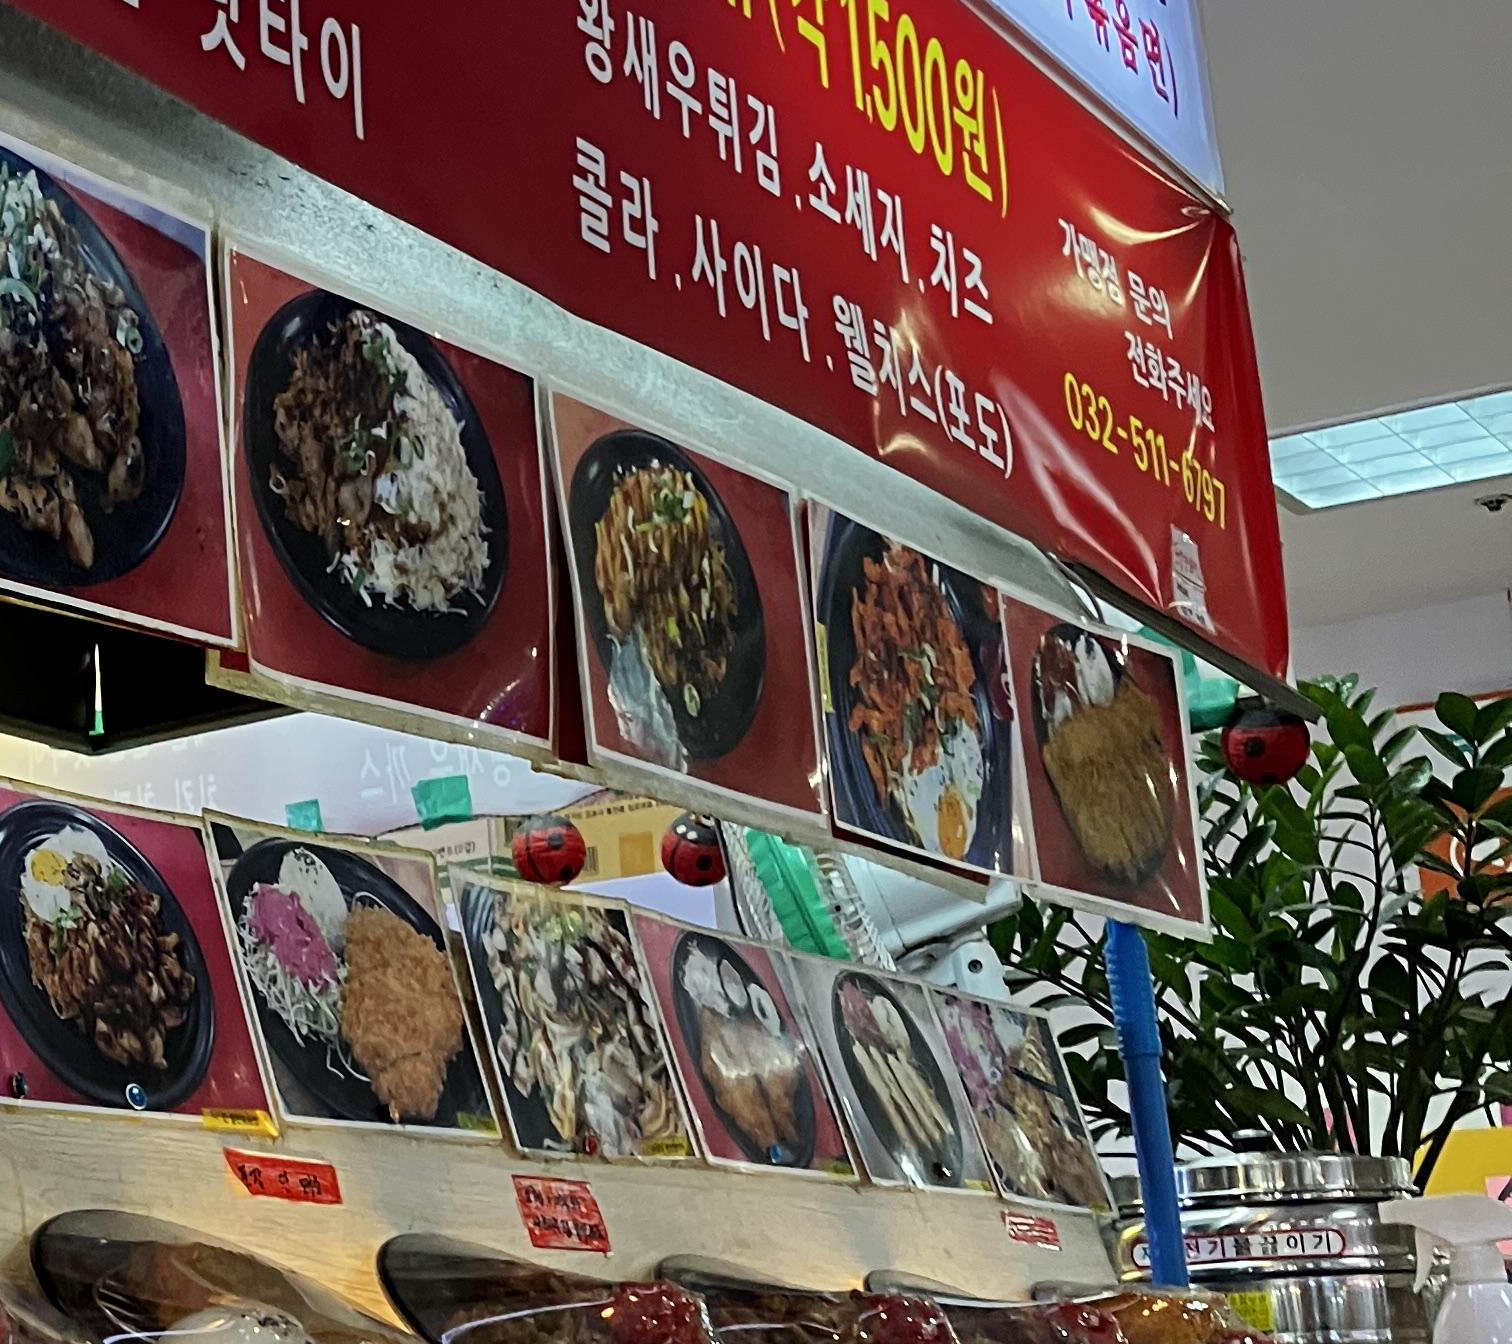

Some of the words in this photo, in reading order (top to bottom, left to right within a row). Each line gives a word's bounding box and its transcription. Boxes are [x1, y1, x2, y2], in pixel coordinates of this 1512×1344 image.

[572, 136, 659, 281] 콜라
[1127, 270, 1173, 340] 문의
[1064, 373, 1225, 530] 032-511-6797
